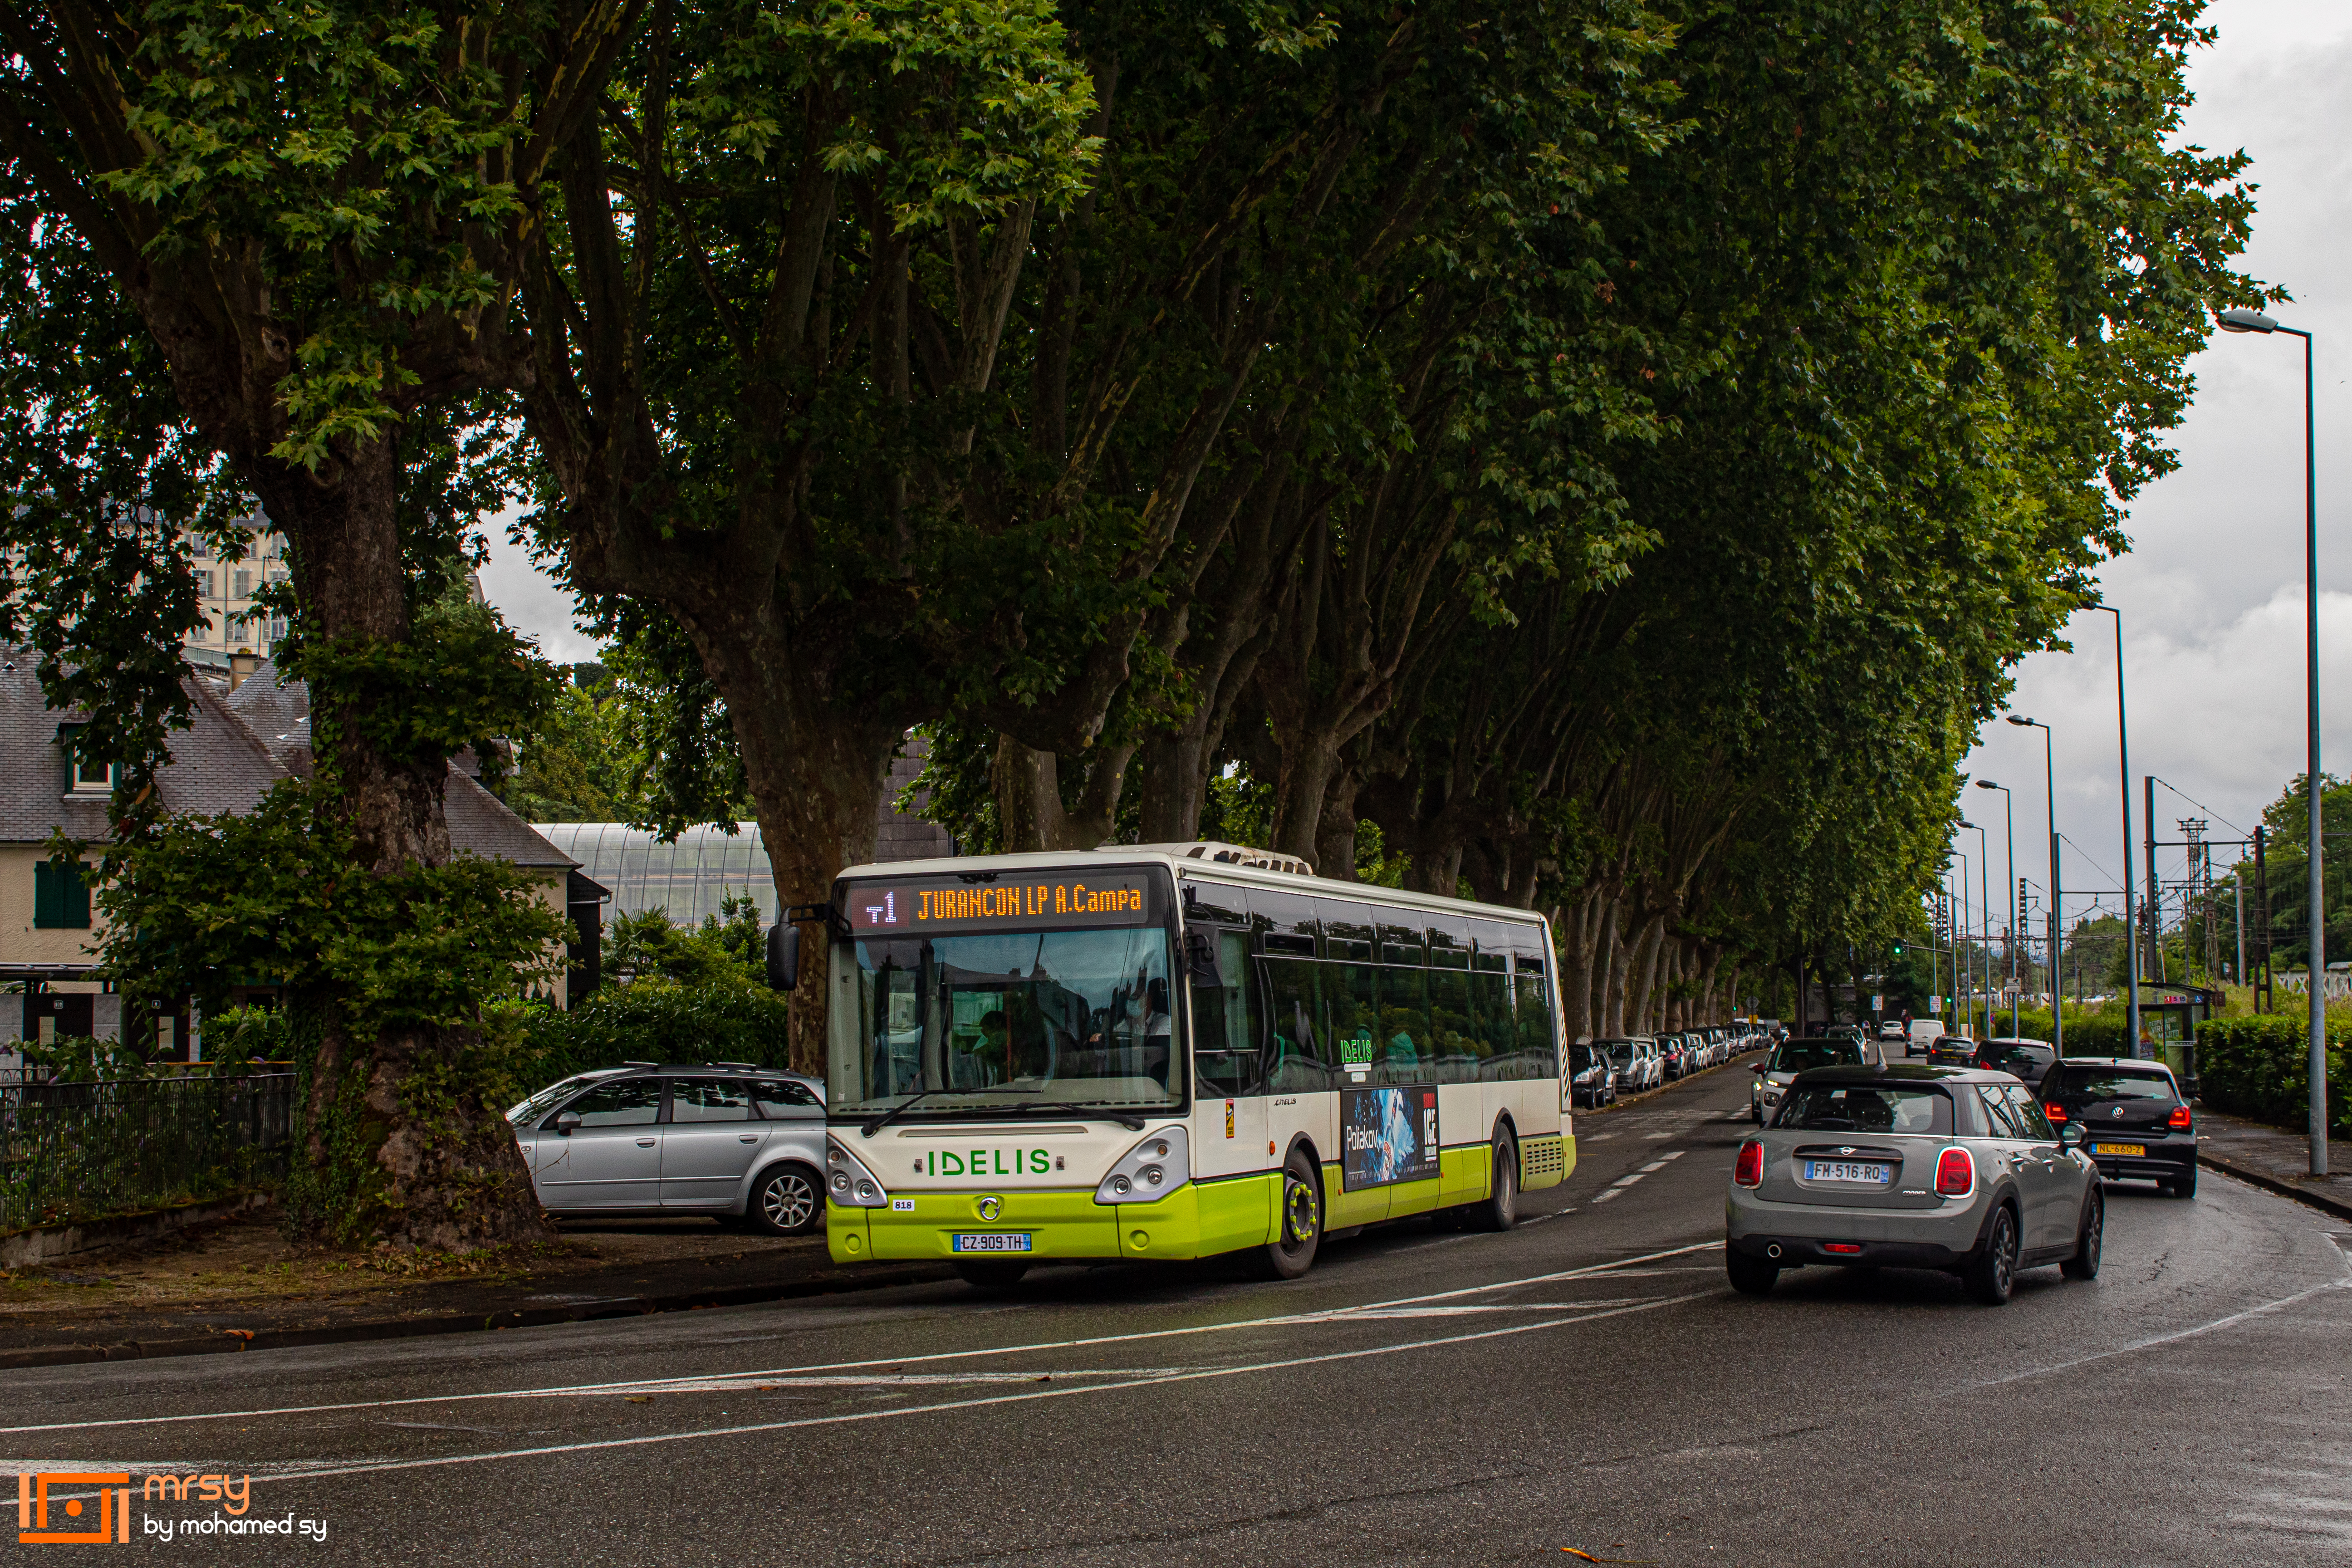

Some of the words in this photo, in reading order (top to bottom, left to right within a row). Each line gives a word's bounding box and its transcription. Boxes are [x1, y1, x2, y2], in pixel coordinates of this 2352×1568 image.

[866, 892, 897, 923] T1
[918, 887, 1020, 920] JURANCON
[1027, 885, 1048, 914] LP
[2158, 1029, 2179, 1039] MJITO
[1341, 1039, 1372, 1063] IDELIS
[1347, 1124, 1378, 1151] Poliakov
[2099, 1145, 2141, 1154] NL-660-Z
[929, 1149, 1050, 1176] IDELIS
[1814, 1163, 1880, 1180] FM-516-RQ
[962, 1235, 1022, 1249] CZ-909-TH
